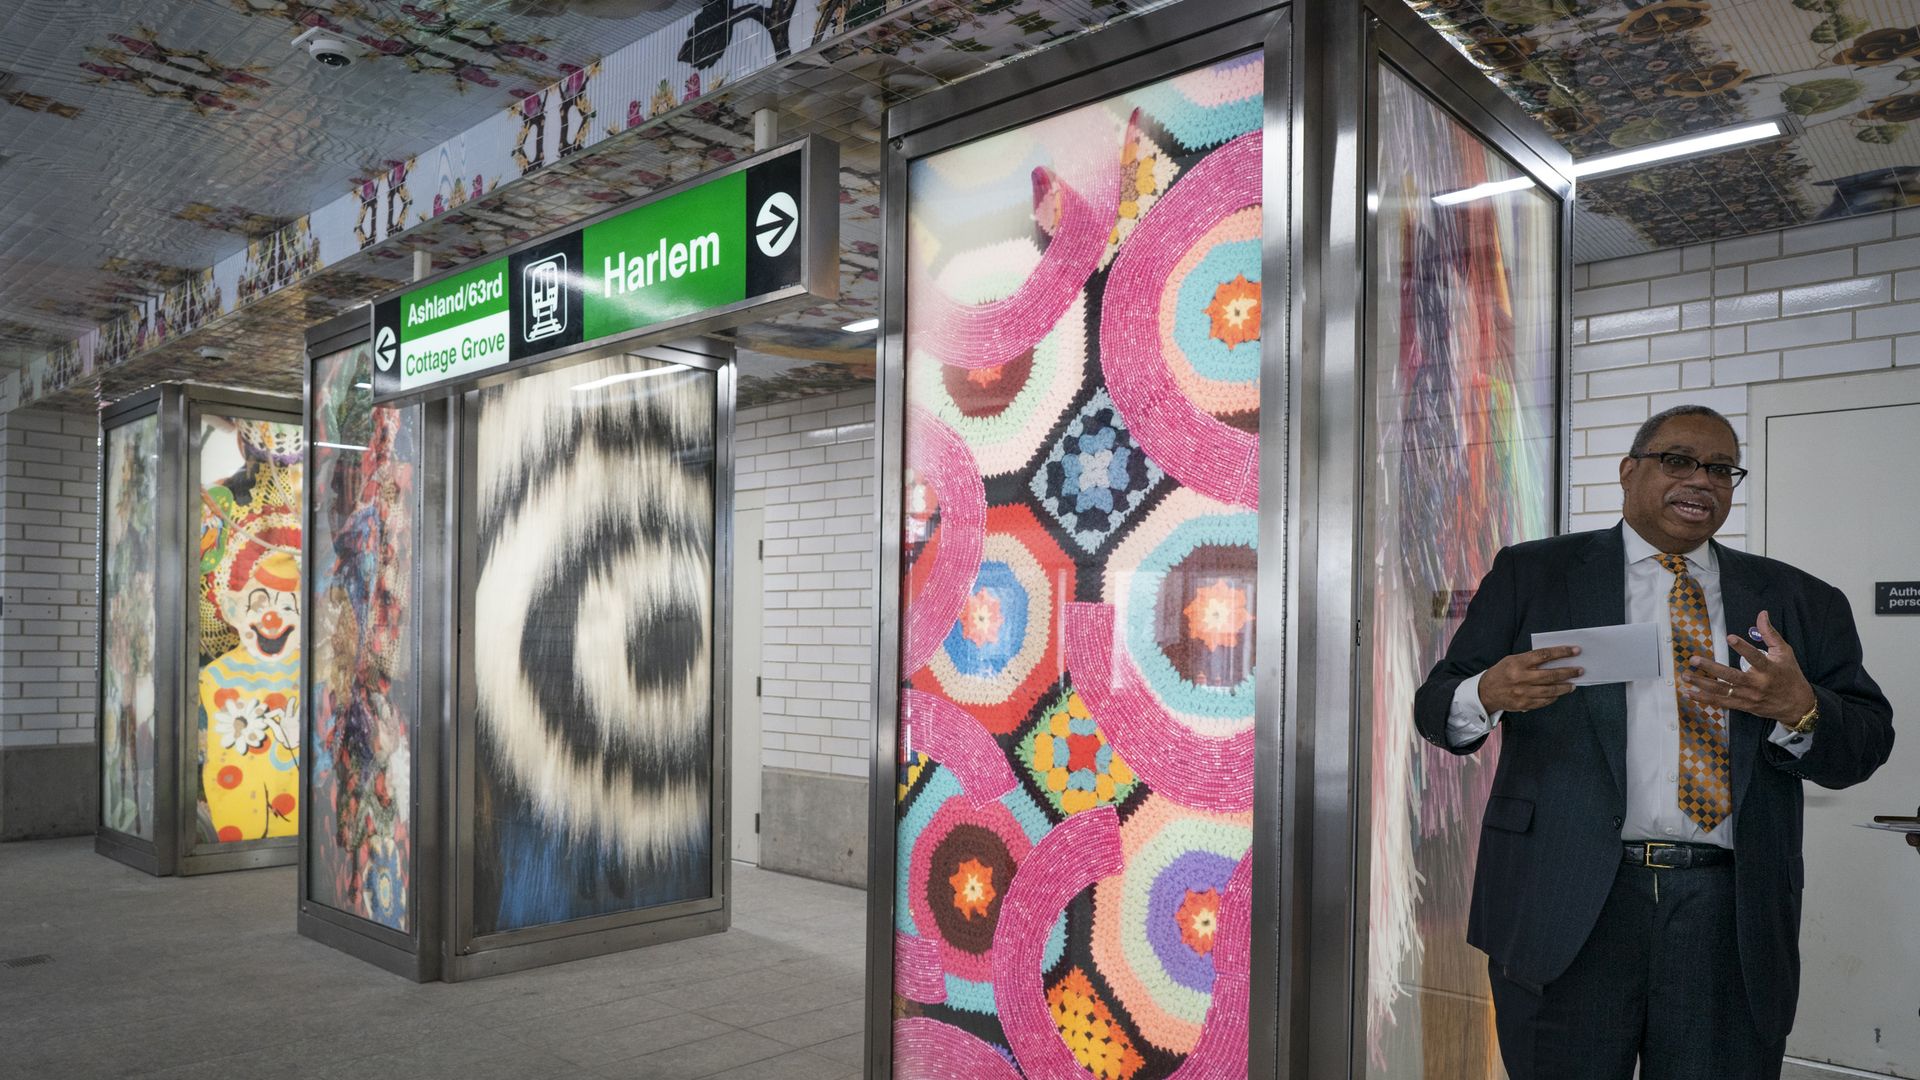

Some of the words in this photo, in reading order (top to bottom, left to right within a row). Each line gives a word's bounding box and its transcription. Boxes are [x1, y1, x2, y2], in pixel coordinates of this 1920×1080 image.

[604, 232, 720, 298] Harlem
[407, 272, 502, 328] Ashland/63rd
[406, 347, 457, 376] Cottage
[461, 333, 505, 361] Grove
